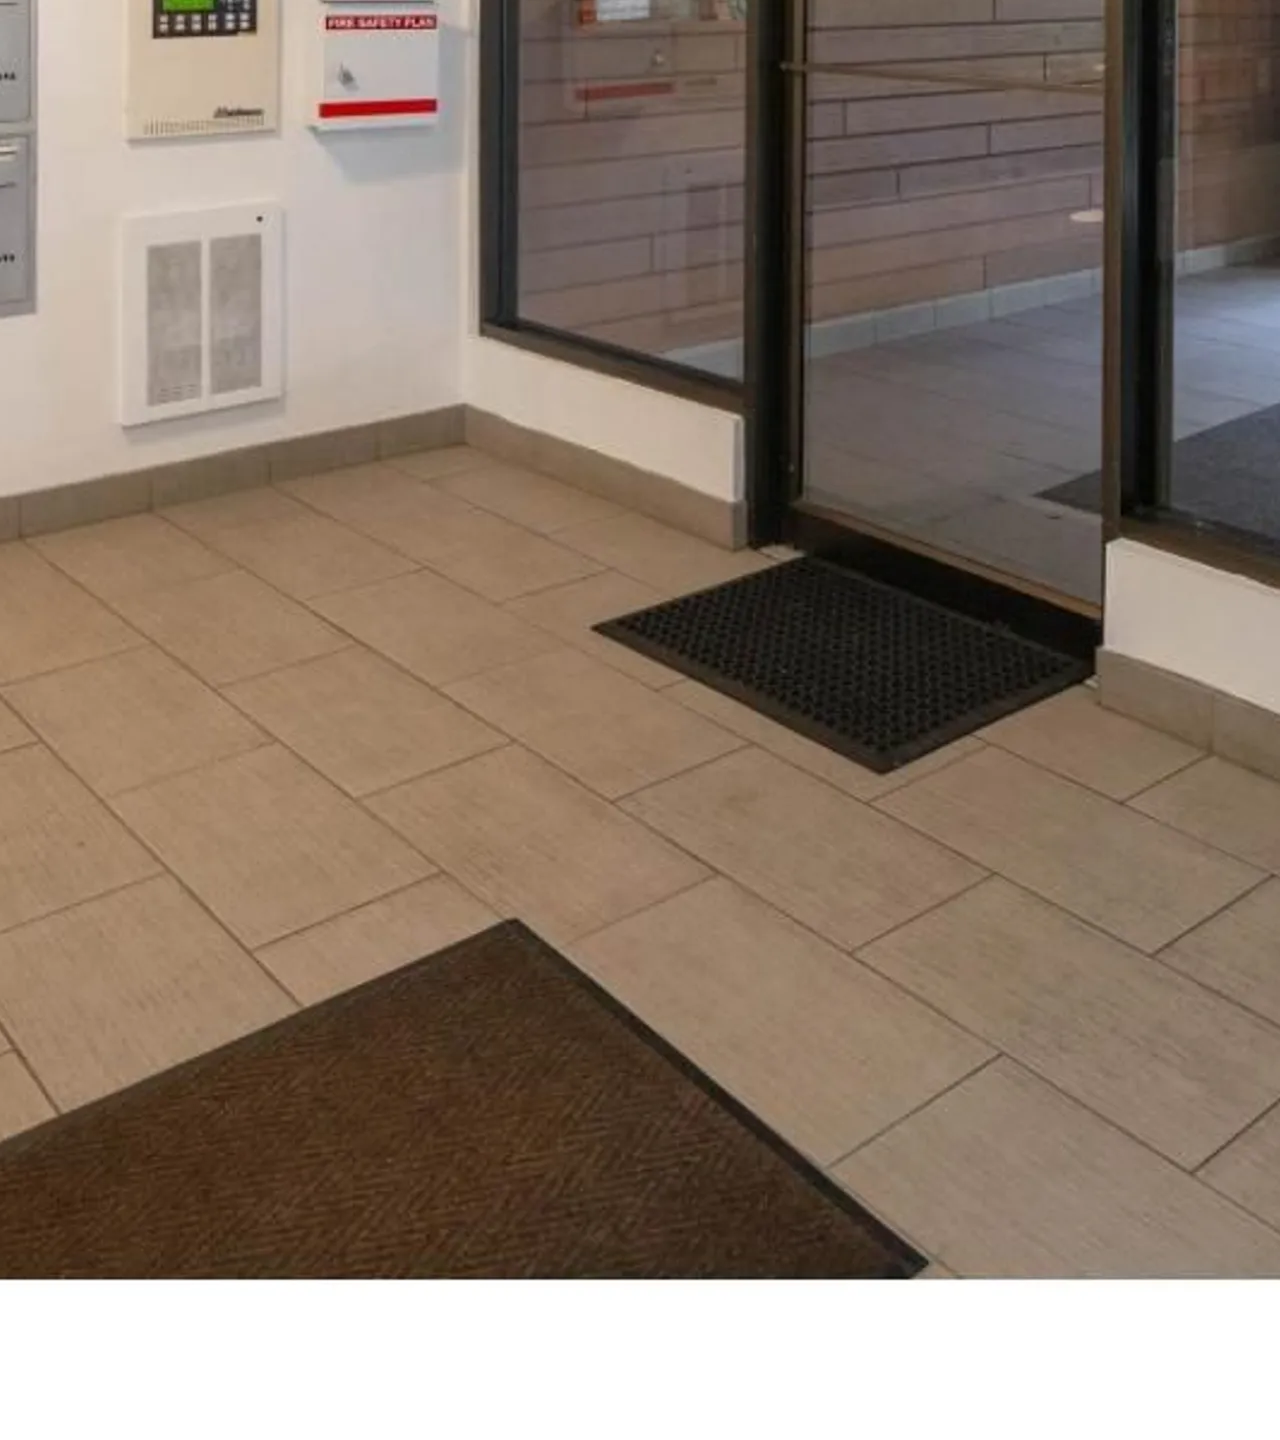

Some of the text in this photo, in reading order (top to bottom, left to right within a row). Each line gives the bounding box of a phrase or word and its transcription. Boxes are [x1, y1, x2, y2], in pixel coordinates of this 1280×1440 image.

[328, 15, 435, 29] FIRE SAFETY PLAN
